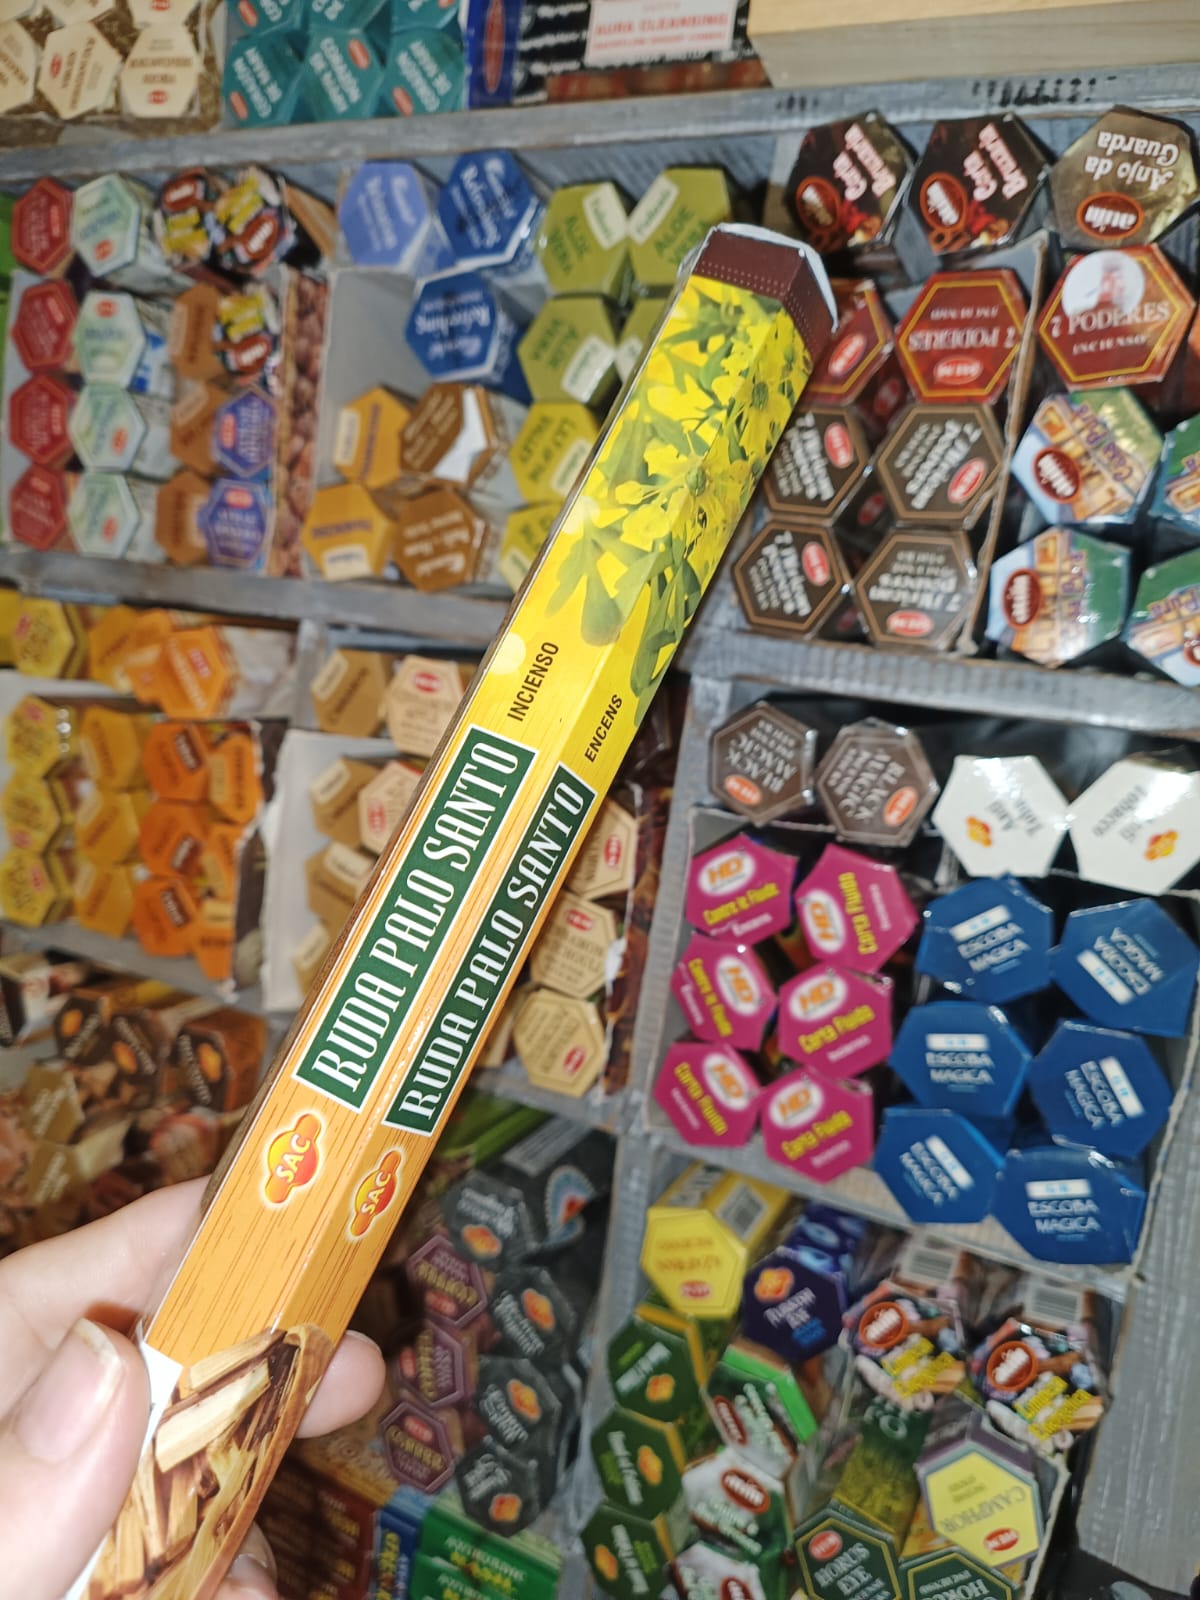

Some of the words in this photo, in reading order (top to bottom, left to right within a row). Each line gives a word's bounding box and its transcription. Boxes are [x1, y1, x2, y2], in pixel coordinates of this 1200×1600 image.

[1081, 154, 1112, 181] da
[1094, 129, 1179, 166] Guarda
[1113, 157, 1173, 191] Anjo
[651, 205, 697, 257] ALOE
[906, 326, 997, 349] PODERES
[1067, 299, 1172, 336] PODERES
[1068, 400, 1109, 445] Pura
[508, 640, 560, 722] INCIENSO
[585, 693, 624, 764] ENCENS
[720, 745, 786, 793] BLACK
[728, 730, 798, 781] MAGIC
[835, 747, 891, 816] MAGIC
[851, 759, 905, 826] BLACK
[835, 868, 866, 913] Fluido
[311, 968, 406, 1093] RUDA
[370, 868, 455, 979] PALO
[435, 739, 520, 873] SANTO
[850, 911, 880, 954] Corta
[957, 919, 1025, 960] ESCOBA
[400, 1008, 478, 1120] RUDA
[454, 906, 525, 1011] PALO
[508, 781, 586, 908] SANTO
[968, 935, 1032, 973] MAGICA
[1090, 930, 1151, 997] ESCOBA
[1107, 922, 1164, 984] MAGICA
[797, 1021, 840, 1055] Corta
[833, 1001, 878, 1036] Fluido
[925, 1053, 996, 1070] ESCOBA
[930, 1068, 994, 1086] MAGICA
[672, 1062, 706, 1102] Corta
[694, 1096, 730, 1139] Fluido
[1064, 1068, 1106, 1130] MAGICA
[1079, 1059, 1125, 1128] ESCOBA
[780, 1128, 821, 1162] Corta
[813, 1106, 856, 1142] Fluido
[281, 1132, 314, 1187] SAC
[897, 1150, 947, 1209] MAGICA
[908, 1141, 960, 1203] ESCOBA
[358, 1169, 393, 1218] SAC
[1028, 1201, 1100, 1217] ESCOBA
[1035, 1219, 1100, 1233] MAGICA
[937, 1481, 1026, 1535] CAMPHOR
[813, 1541, 871, 1587] HORUS
[982, 1528, 1017, 1550] HEM
[836, 1564, 873, 1597] EYE
